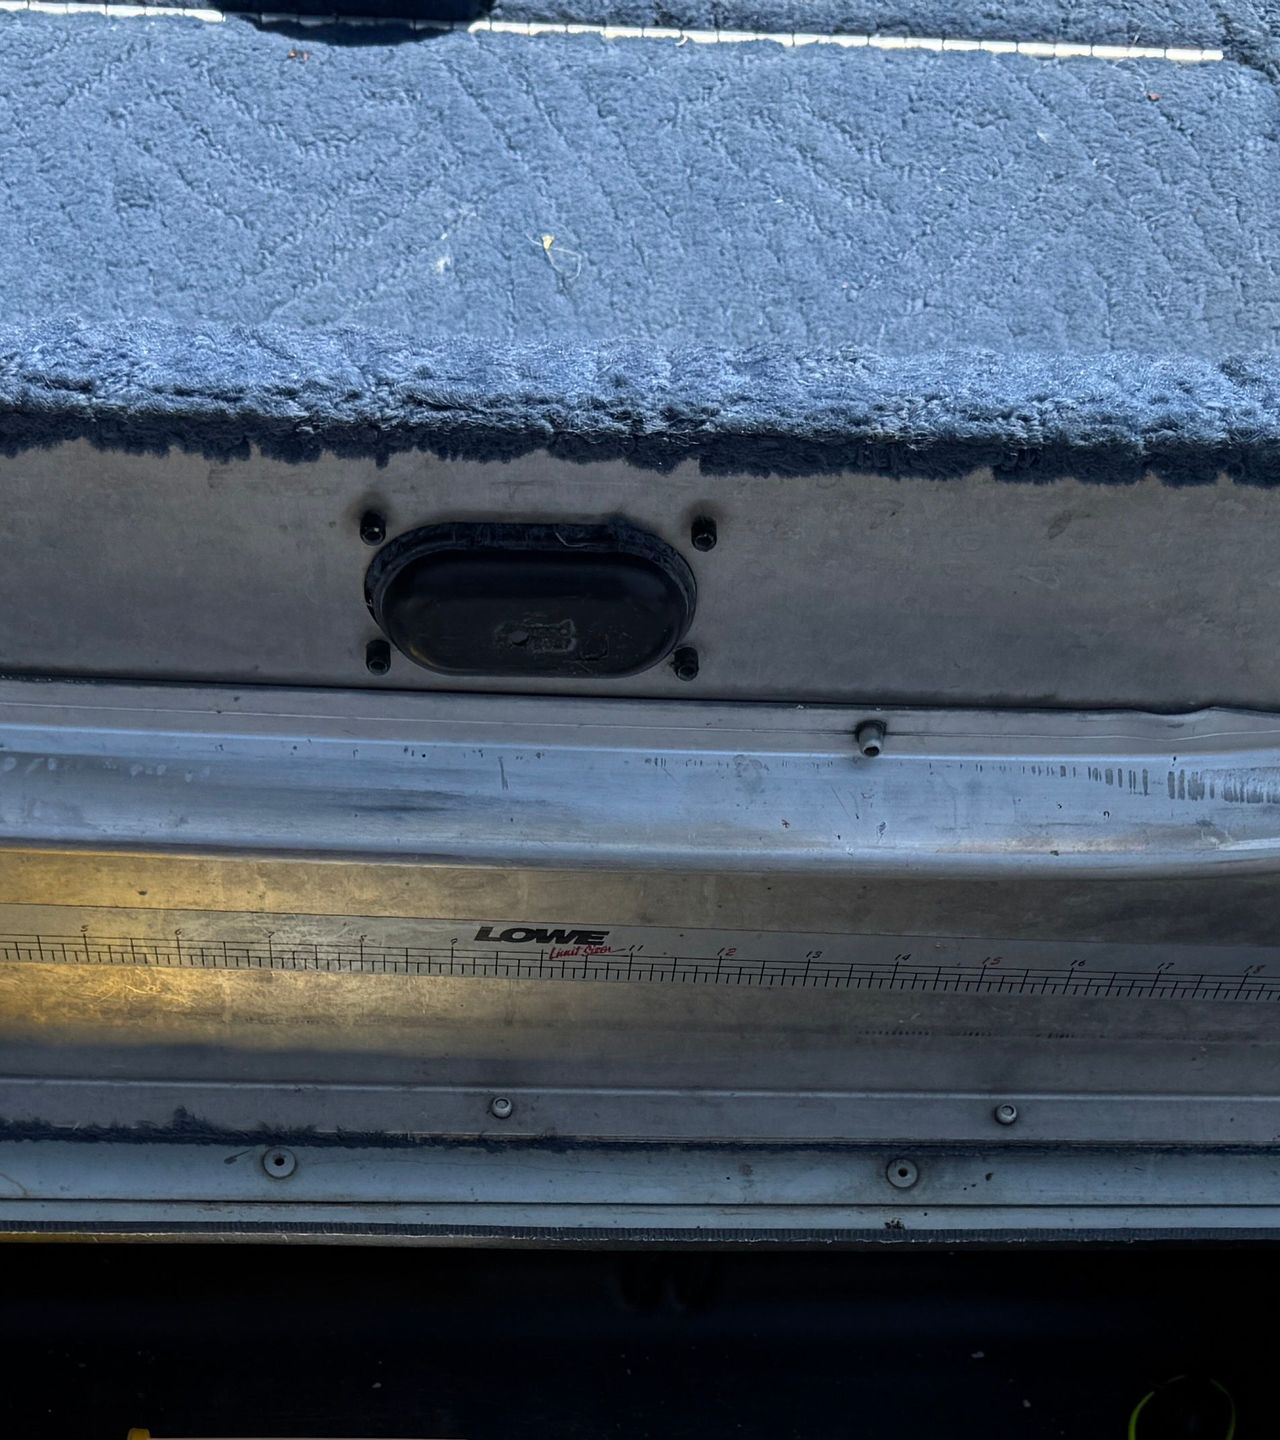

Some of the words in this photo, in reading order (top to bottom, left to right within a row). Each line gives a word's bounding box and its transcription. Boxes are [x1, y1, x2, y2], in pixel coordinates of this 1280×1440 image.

[474, 926, 610, 945] LOWE
[717, 947, 737, 956] 12
[806, 950, 823, 958] 13
[894, 953, 912, 961] 14
[982, 956, 1003, 965] 15
[1070, 959, 1087, 967] 16
[1157, 962, 1175, 970] 17
